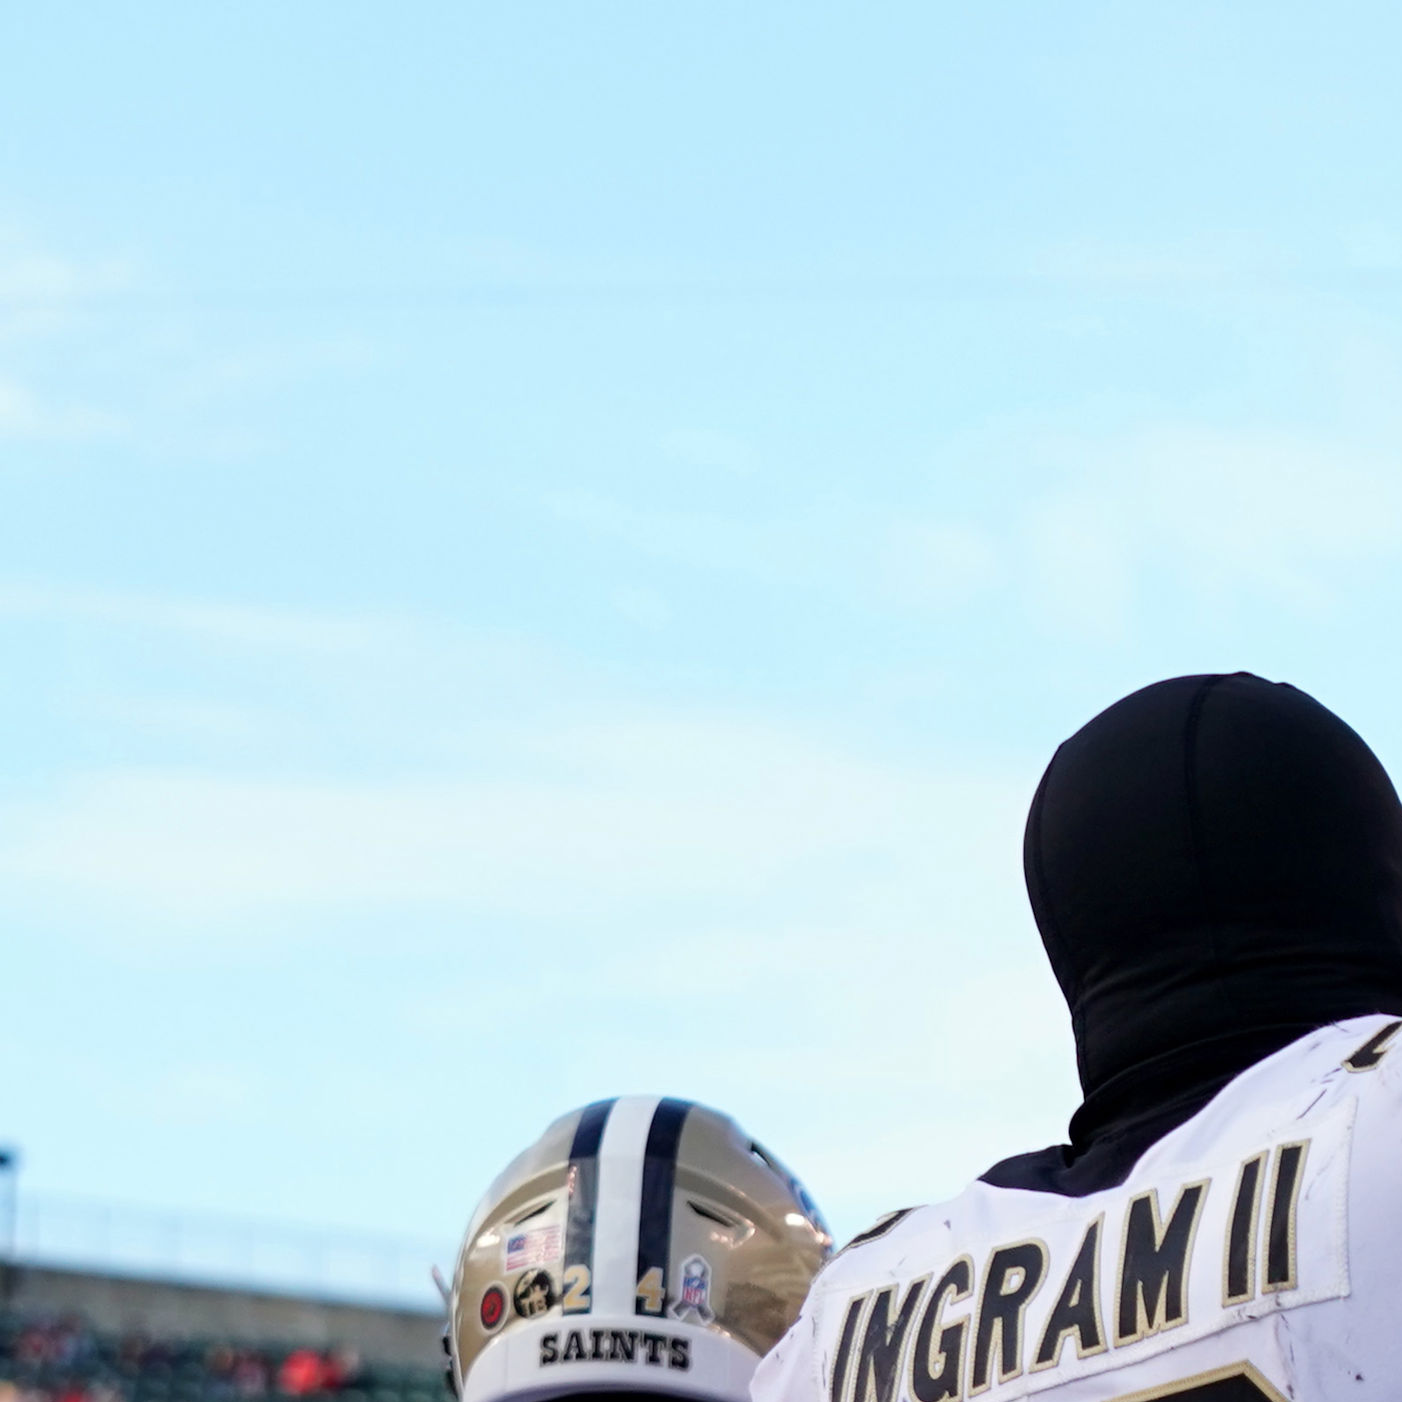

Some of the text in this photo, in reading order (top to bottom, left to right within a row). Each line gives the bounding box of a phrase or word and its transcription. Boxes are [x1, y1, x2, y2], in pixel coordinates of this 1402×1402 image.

[1221, 1139, 1311, 1307] II
[562, 1264, 666, 1313] 2 4
[539, 1328, 692, 1371] SAINTS
